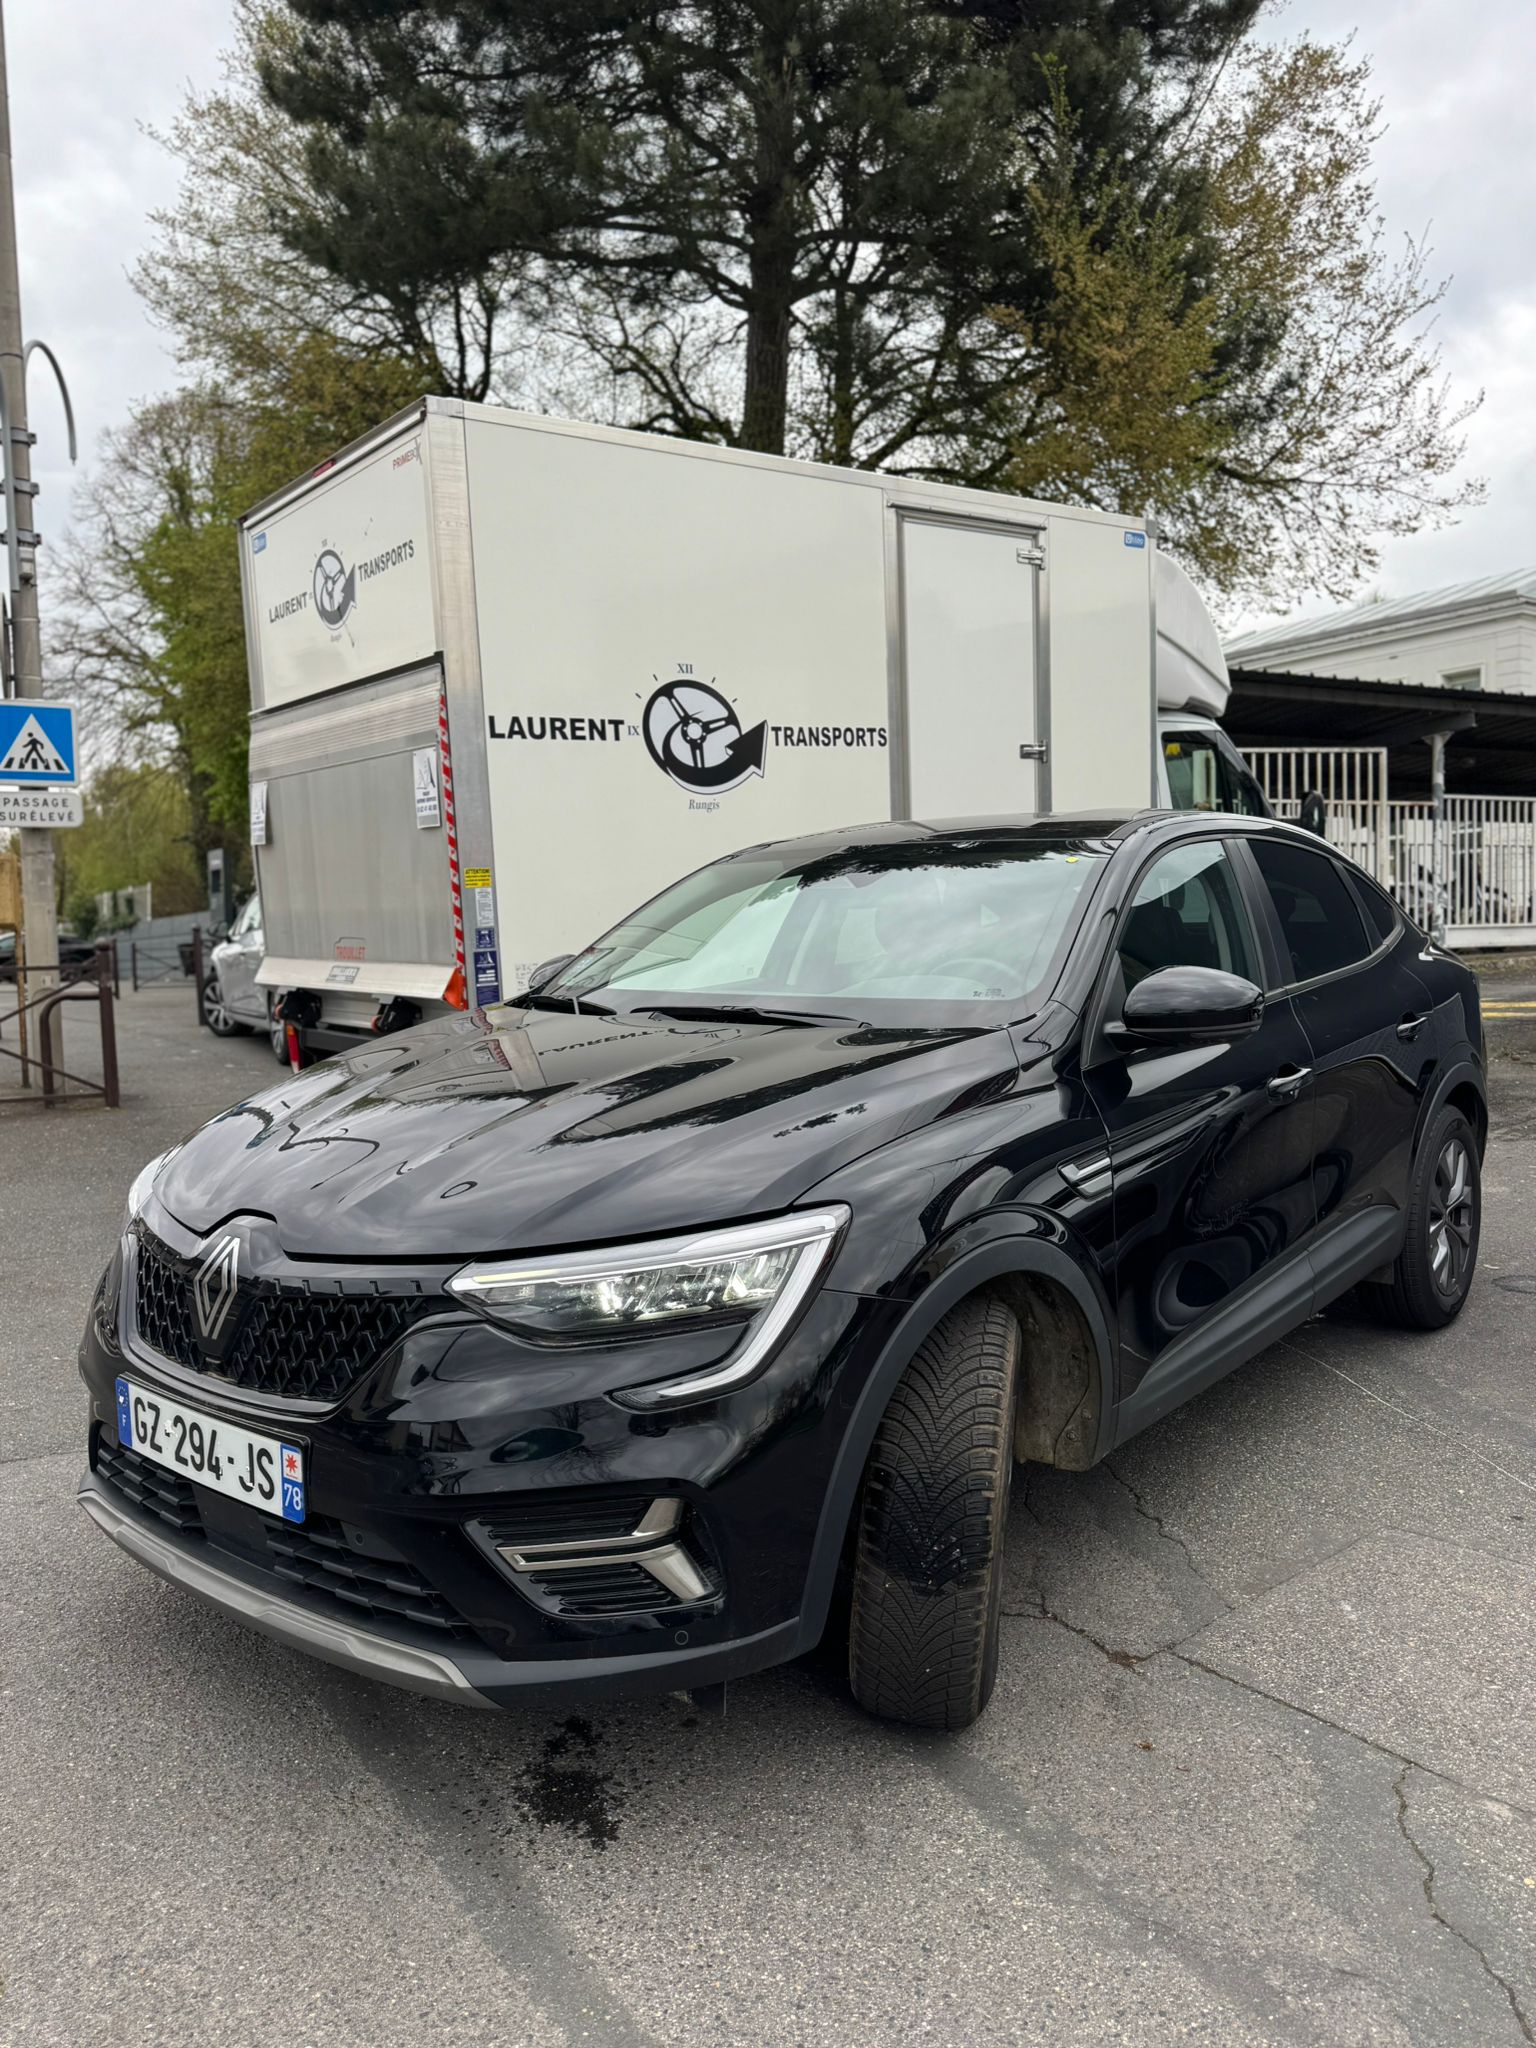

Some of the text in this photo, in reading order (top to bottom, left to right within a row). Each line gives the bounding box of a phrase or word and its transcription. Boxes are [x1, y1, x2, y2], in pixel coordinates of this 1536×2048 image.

[268, 539, 414, 623] LAURENT TRANSPORTS
[677, 663, 694, 674] XII
[488, 715, 888, 747] LAURENT TRANSPORTS
[627, 725, 640, 736] IX
[3, 797, 69, 808] PASSAGE
[688, 798, 720, 812] Rungis
[0, 810, 75, 821] SURÉLEVÉ
[284, 1483, 301, 1510] 78
